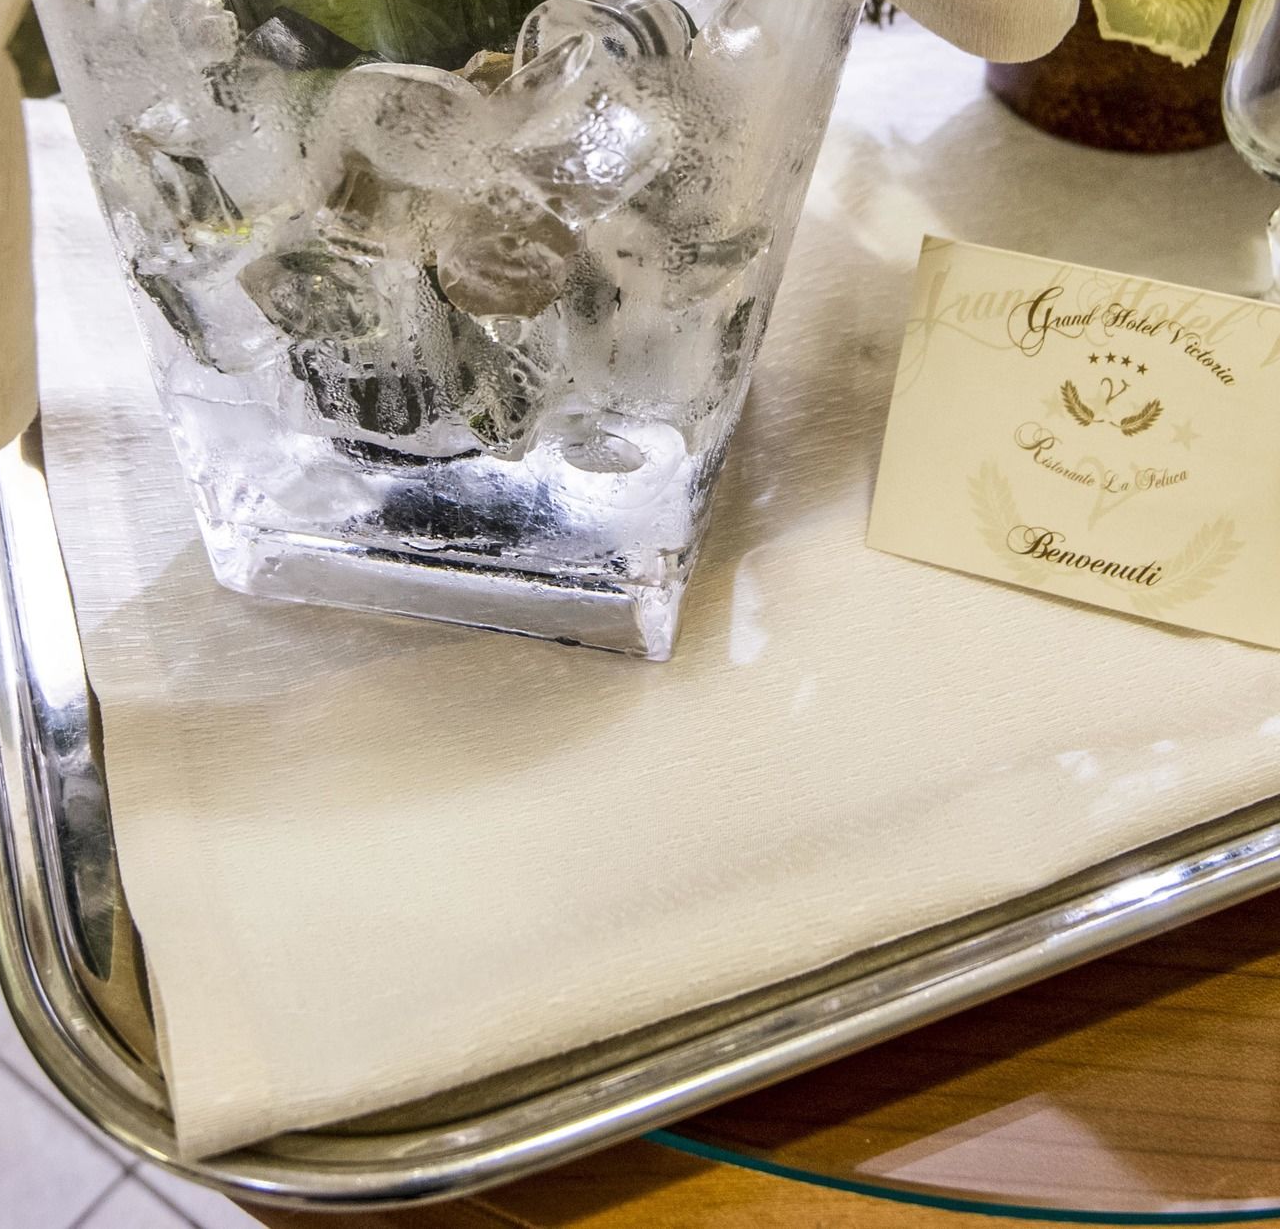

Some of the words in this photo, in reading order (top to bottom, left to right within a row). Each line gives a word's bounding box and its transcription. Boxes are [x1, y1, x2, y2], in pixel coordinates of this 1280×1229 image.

[1007, 285, 1100, 357] Grand
[1101, 302, 1168, 338] Hotel
[1167, 321, 1236, 387] Victoria
[1014, 421, 1096, 487] Ristorante
[1102, 469, 1130, 494] La
[1134, 467, 1188, 491] Feluca
[1006, 525, 1163, 587] Benvenuti
